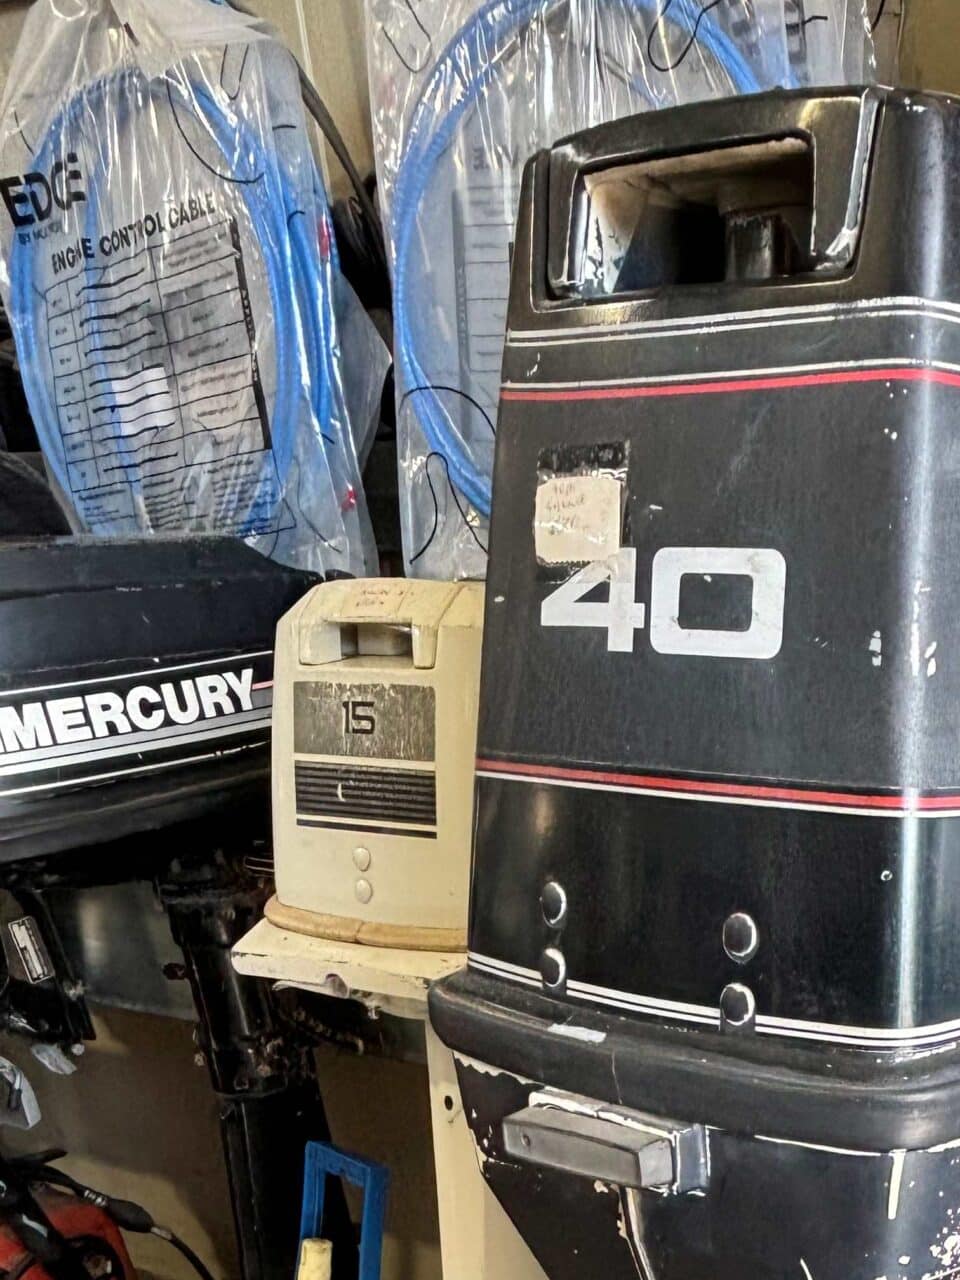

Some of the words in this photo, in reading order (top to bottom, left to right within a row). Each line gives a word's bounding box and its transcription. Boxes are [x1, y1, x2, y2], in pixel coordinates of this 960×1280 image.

[52, 238, 95, 274] ENGE
[168, 191, 215, 229] CABLE
[541, 547, 787, 659] 40
[0, 668, 254, 753] MERCURY
[342, 700, 376, 735] 15
